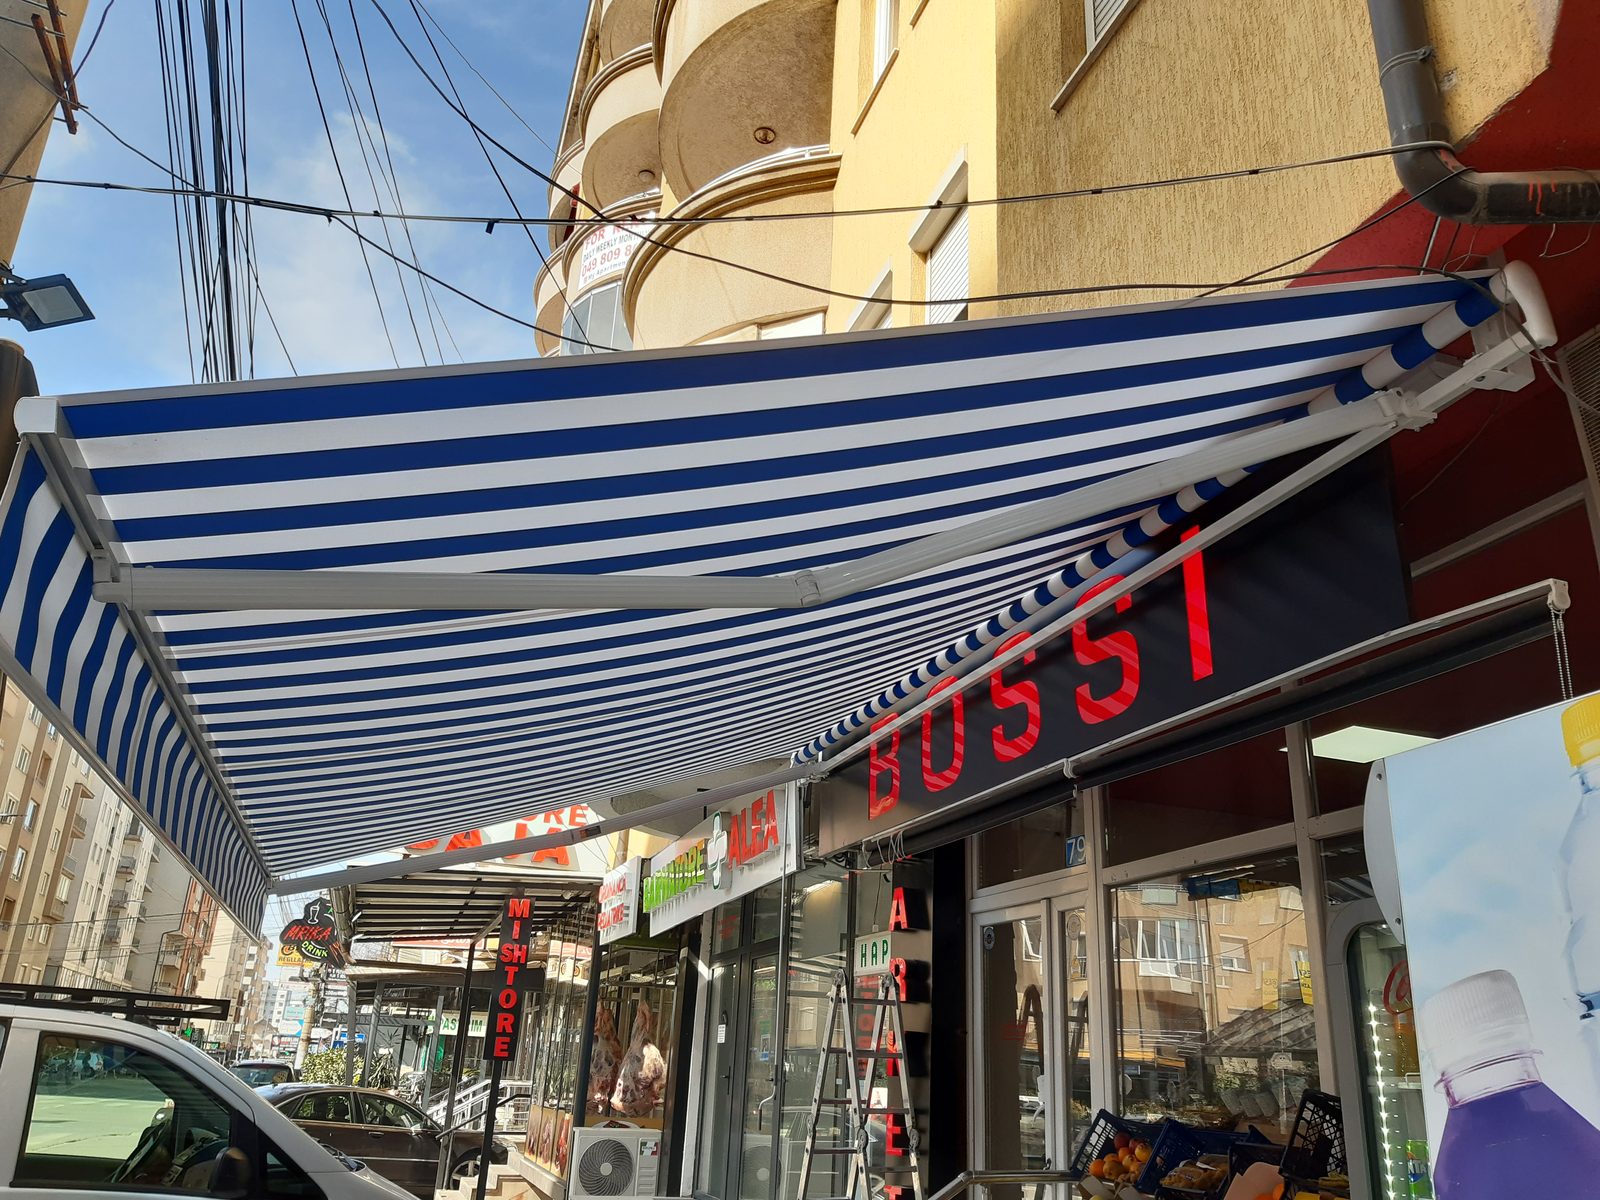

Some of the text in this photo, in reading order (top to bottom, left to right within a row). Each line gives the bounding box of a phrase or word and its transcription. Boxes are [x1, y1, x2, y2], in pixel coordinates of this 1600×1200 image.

[585, 228, 606, 249] FOR
[596, 237, 618, 254] WEEKLY
[582, 258, 597, 277] 049
[600, 247, 621, 266] 809
[869, 524, 1214, 820] BOSSI
[728, 789, 779, 871] ALEA
[1066, 836, 1087, 865] 79
[301, 941, 329, 958] DRINK
